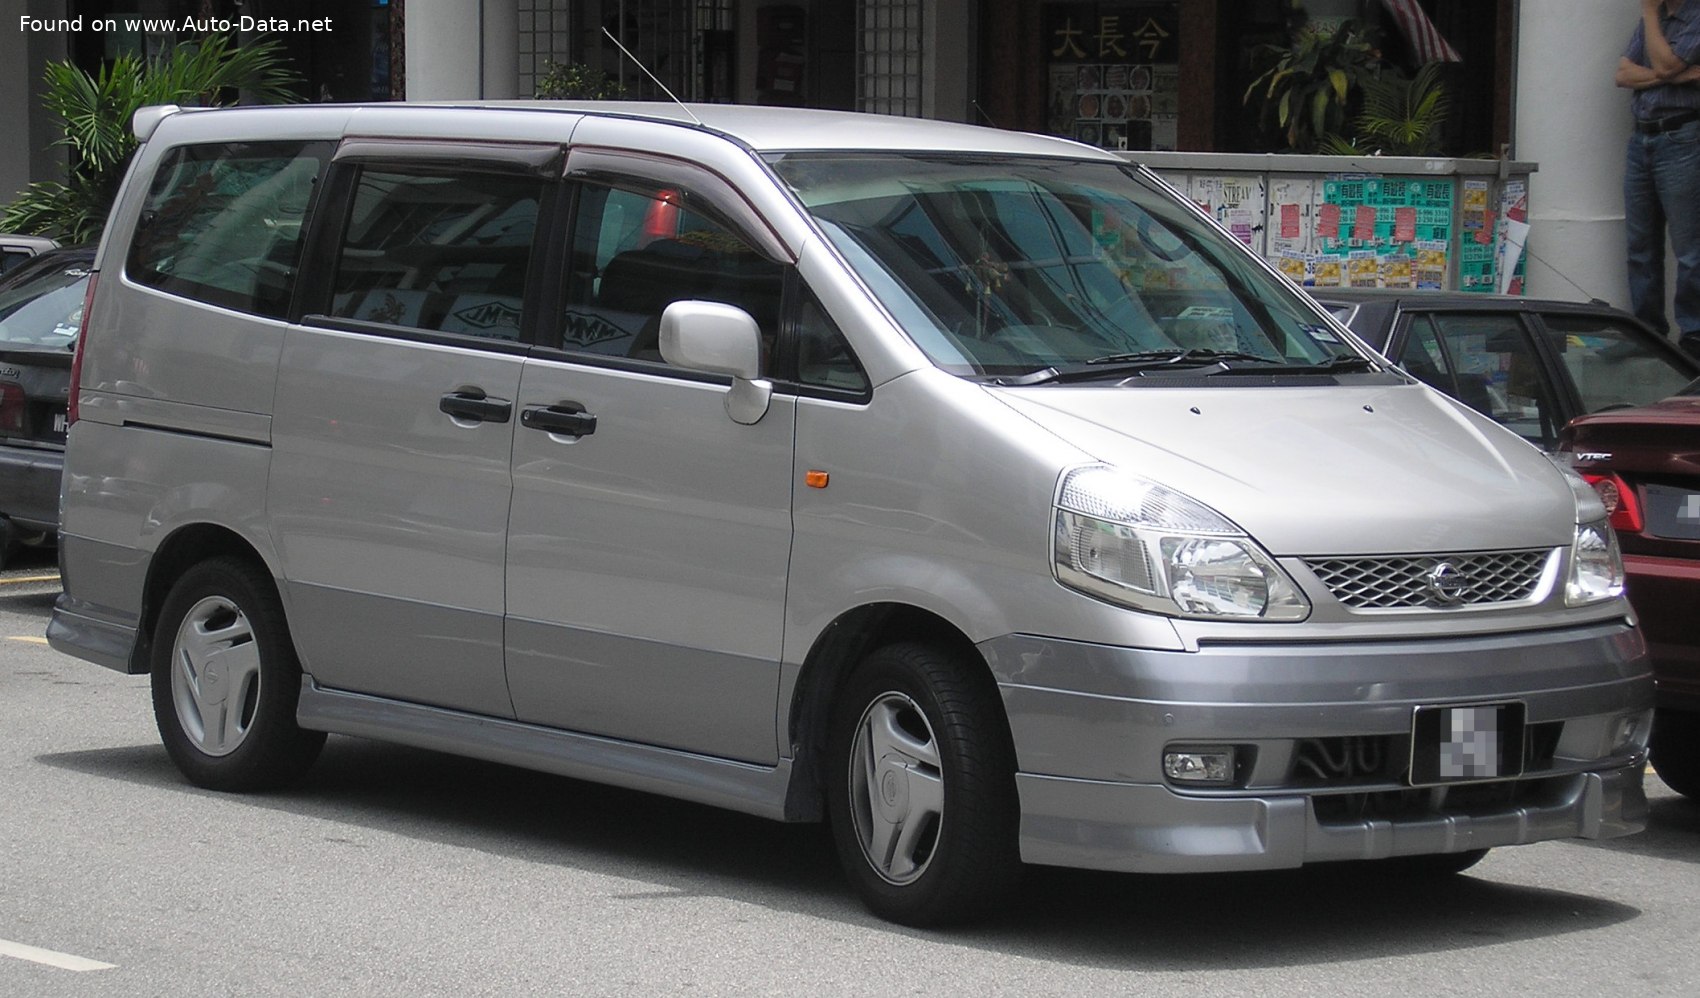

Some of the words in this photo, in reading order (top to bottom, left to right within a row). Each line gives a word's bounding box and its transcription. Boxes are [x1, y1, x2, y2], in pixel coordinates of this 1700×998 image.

[1052, 16, 1169, 59] 大長今
[1577, 452, 1613, 461] VTEC
